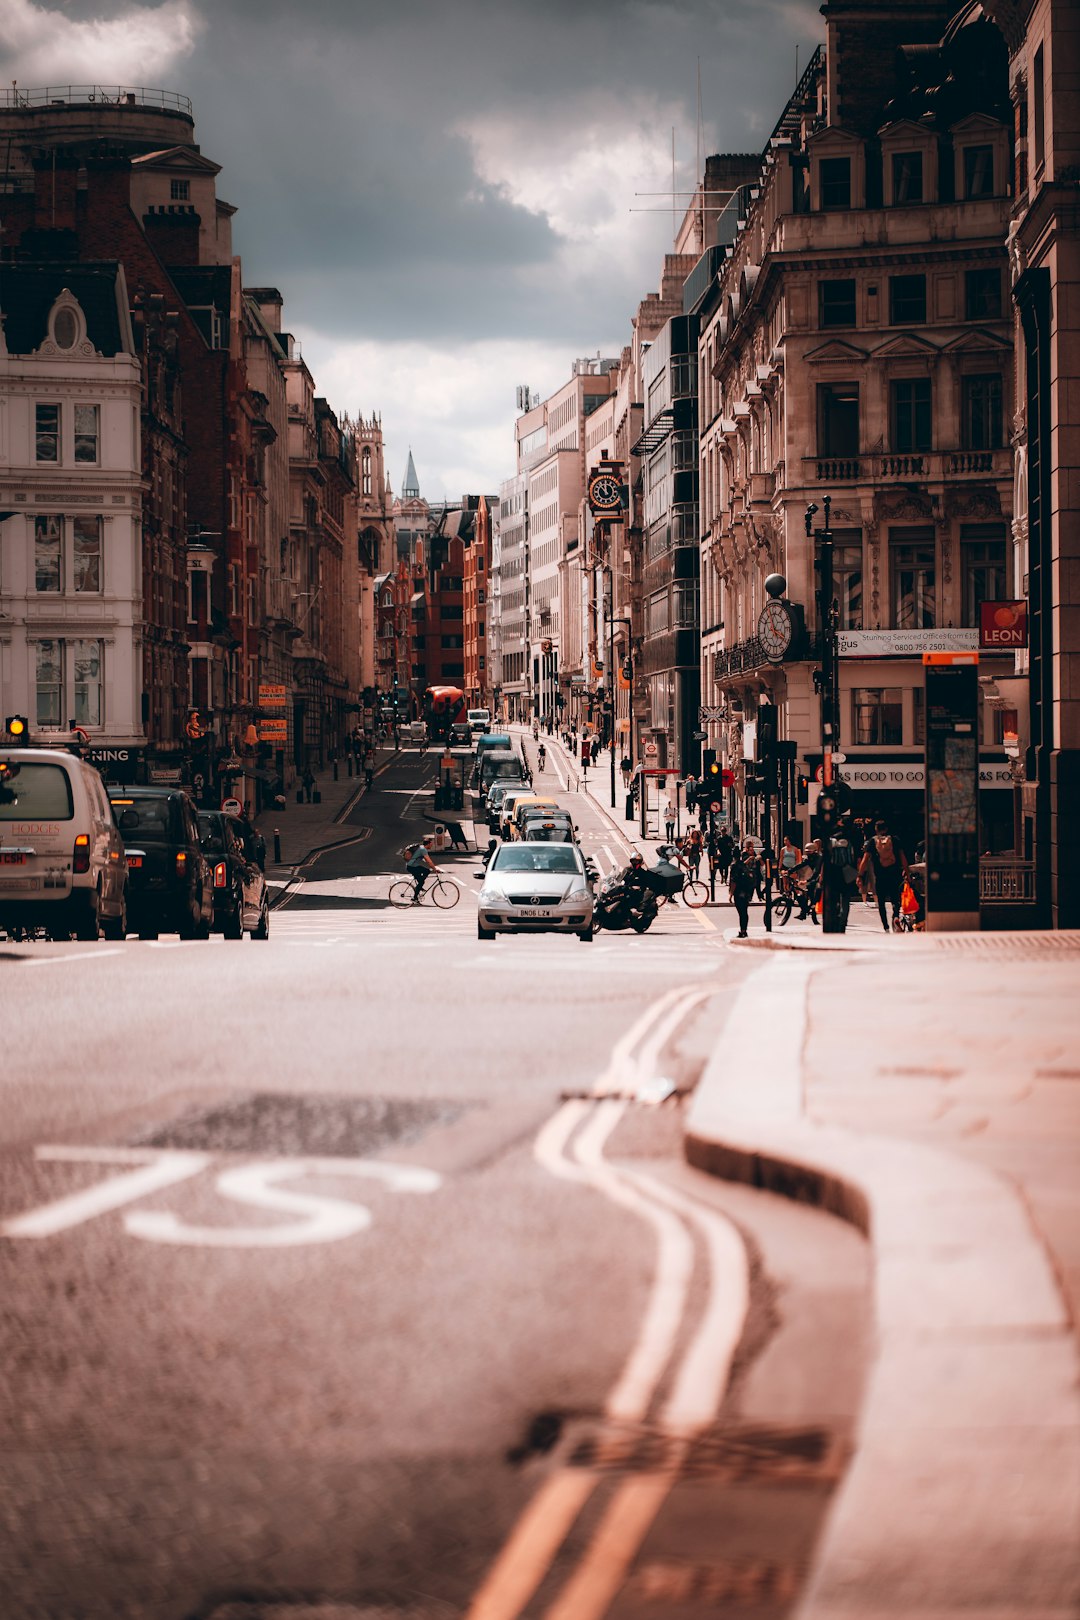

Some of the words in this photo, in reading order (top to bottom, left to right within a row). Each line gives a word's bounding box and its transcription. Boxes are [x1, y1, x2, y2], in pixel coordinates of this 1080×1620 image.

[862, 634, 892, 643] Stunning
[892, 633, 922, 641] Serviced
[922, 632, 947, 640] Offices
[947, 632, 963, 640] from
[984, 629, 1023, 642] LEON
[837, 640, 858, 652] egus
[894, 643, 913, 652] 0800
[915, 643, 927, 651] 756
[929, 642, 946, 651] 2501
[91, 749, 129, 762] NING
[854, 771, 887, 782] FOOD
[888, 771, 904, 782] TO
[905, 771, 924, 782] GO
